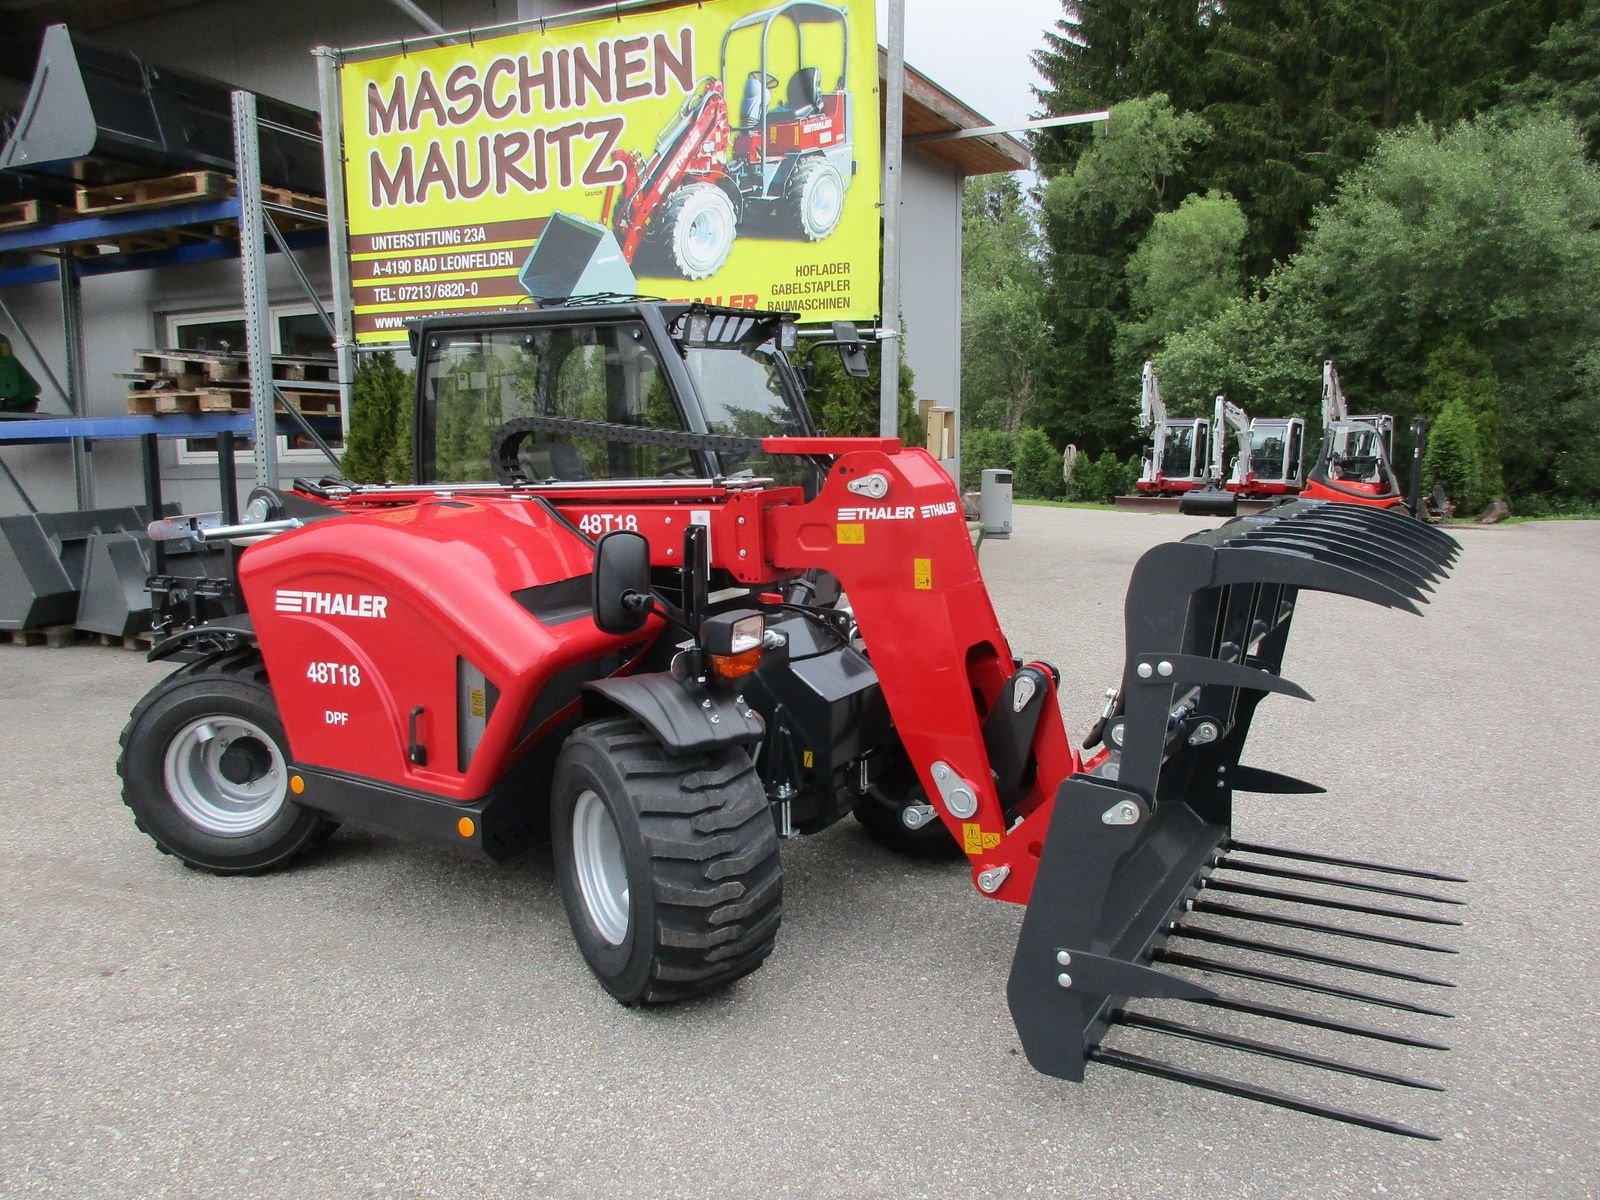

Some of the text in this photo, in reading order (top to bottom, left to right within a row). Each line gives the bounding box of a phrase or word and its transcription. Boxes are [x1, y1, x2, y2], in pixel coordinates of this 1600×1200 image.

[367, 27, 695, 136] MASCHINEN
[370, 117, 625, 206] MAURITZ
[372, 226, 486, 251] UNTERSTIFTUNG 23A
[373, 250, 514, 276] A-4190 BAD LEONFELDEN
[795, 262, 850, 278] HOFLADER
[374, 281, 479, 302] TEL: 07213/6820-0
[771, 279, 850, 296] GABELSTAPLER
[767, 296, 850, 312] BAUMASCHINEN
[579, 514, 638, 534] 48T18
[302, 592, 388, 618] THALER
[307, 662, 361, 687] 48T18
[325, 710, 349, 726] DPF
